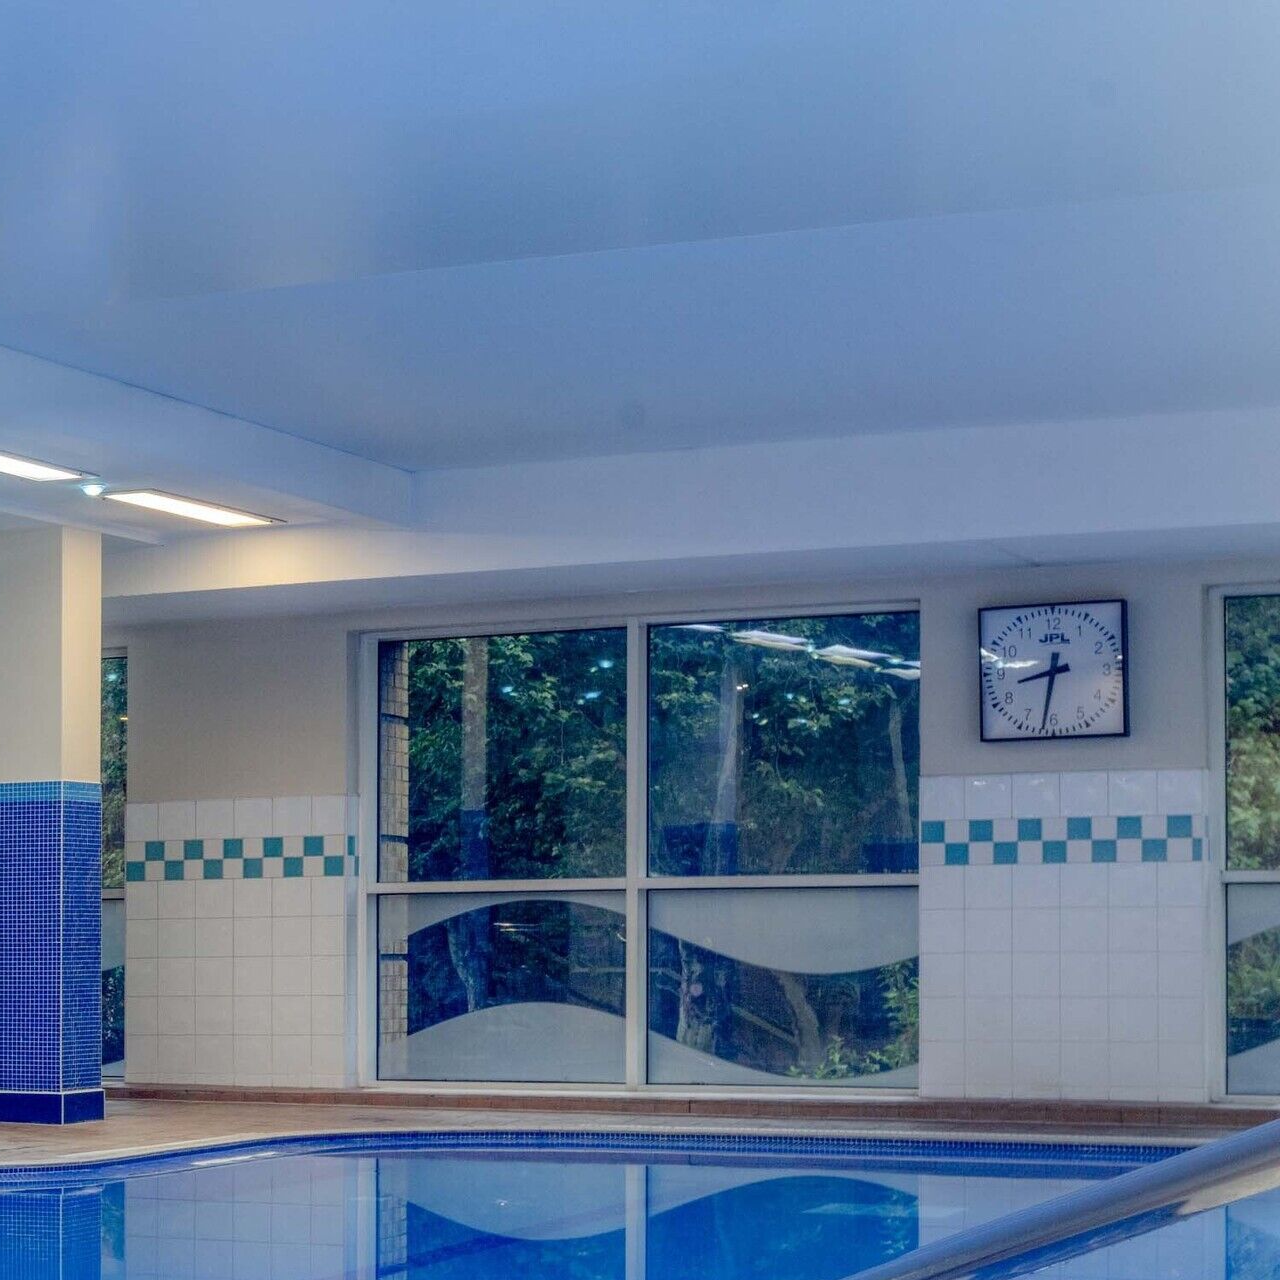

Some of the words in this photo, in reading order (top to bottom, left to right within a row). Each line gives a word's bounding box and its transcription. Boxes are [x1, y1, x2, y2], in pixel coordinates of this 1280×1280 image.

[1047, 617, 1061, 630] 12
[1020, 627, 1032, 639] 11
[1039, 633, 1070, 644] JPL
[1003, 645, 1017, 657] 10
[1094, 641, 1103, 654] 2
[997, 668, 1005, 680] 9
[1102, 662, 1111, 676] 3
[1005, 692, 1013, 704] 8
[1094, 689, 1101, 701] 4
[1024, 708, 1032, 720] 7
[1076, 706, 1085, 719] 5
[1049, 713, 1058, 726] 6
